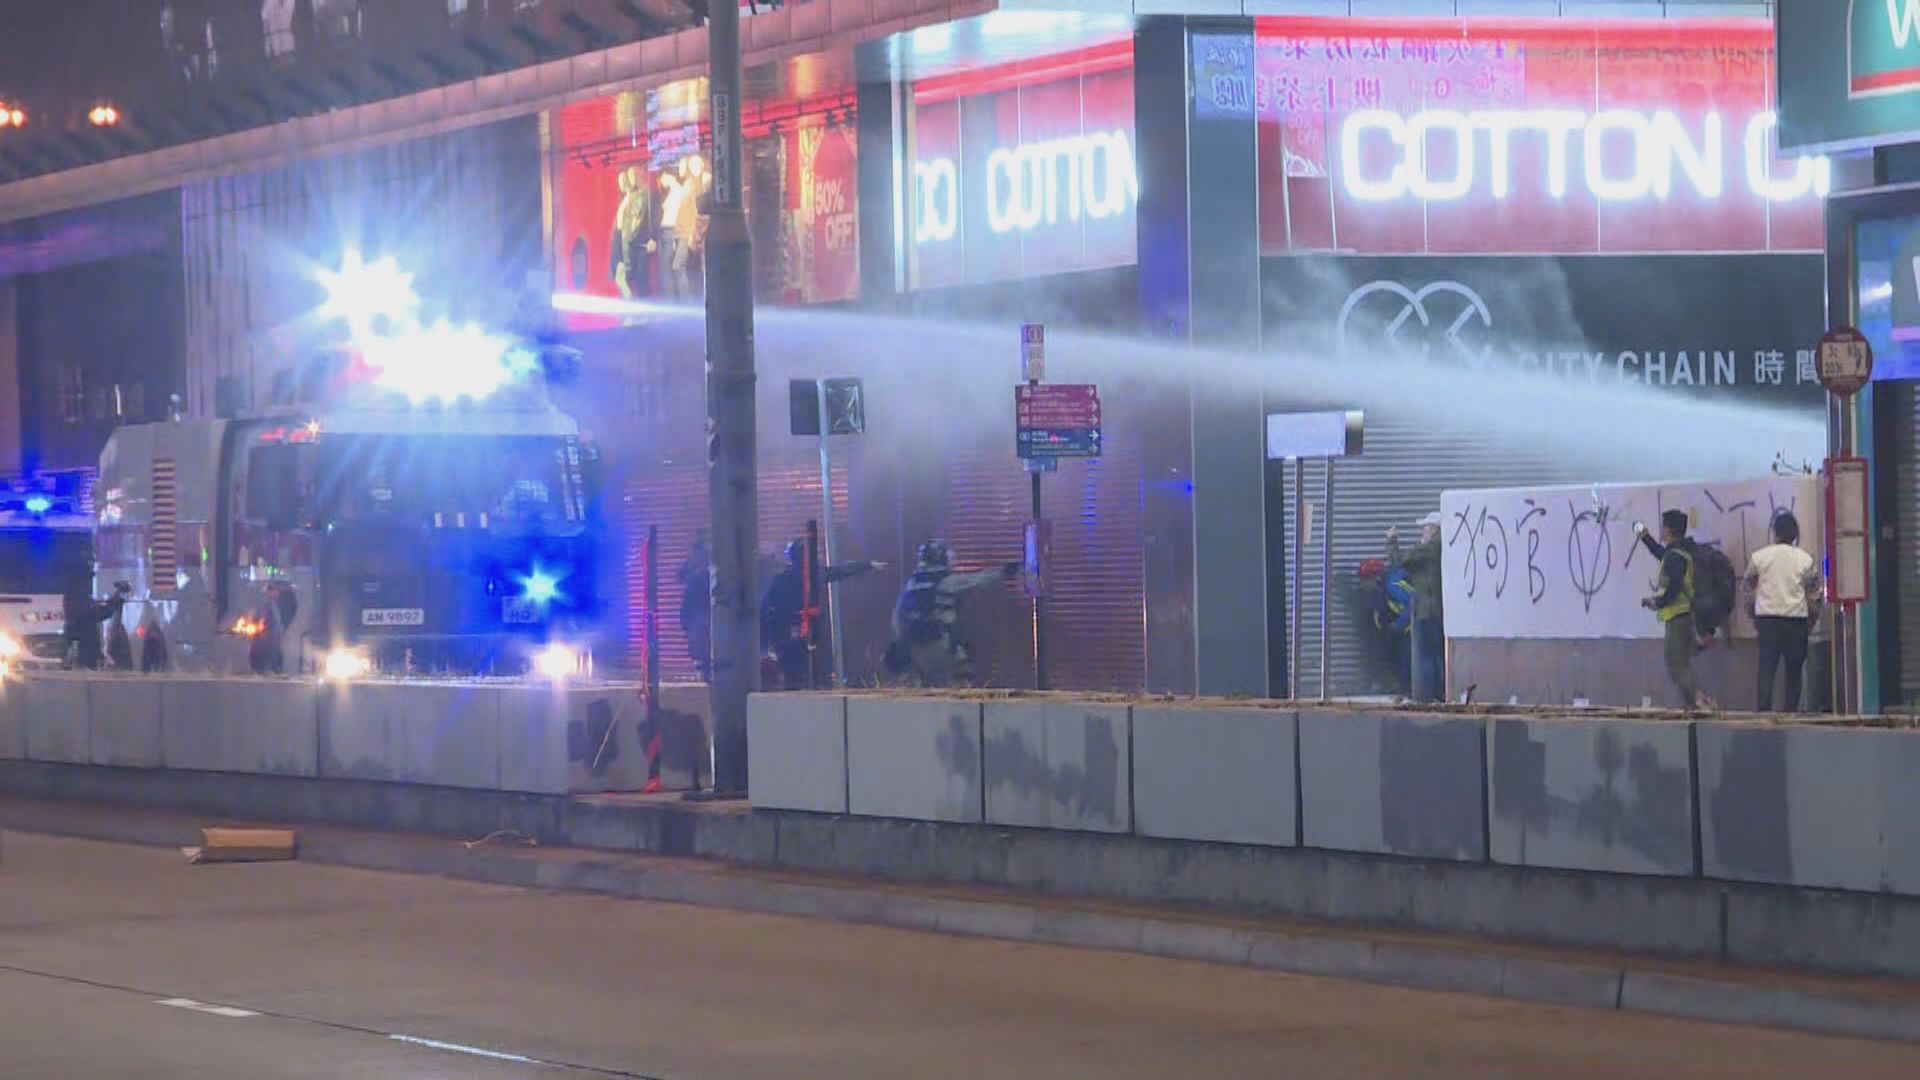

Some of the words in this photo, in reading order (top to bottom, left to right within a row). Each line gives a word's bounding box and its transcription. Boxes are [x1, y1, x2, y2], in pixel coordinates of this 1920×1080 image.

[1342, 111, 1722, 200] COTTON
[815, 179, 845, 215] 50%
[987, 129, 1138, 233] COTTON
[825, 213, 853, 253] OFF
[1519, 350, 1604, 387] CITY
[1617, 350, 1736, 387] CHAIN
